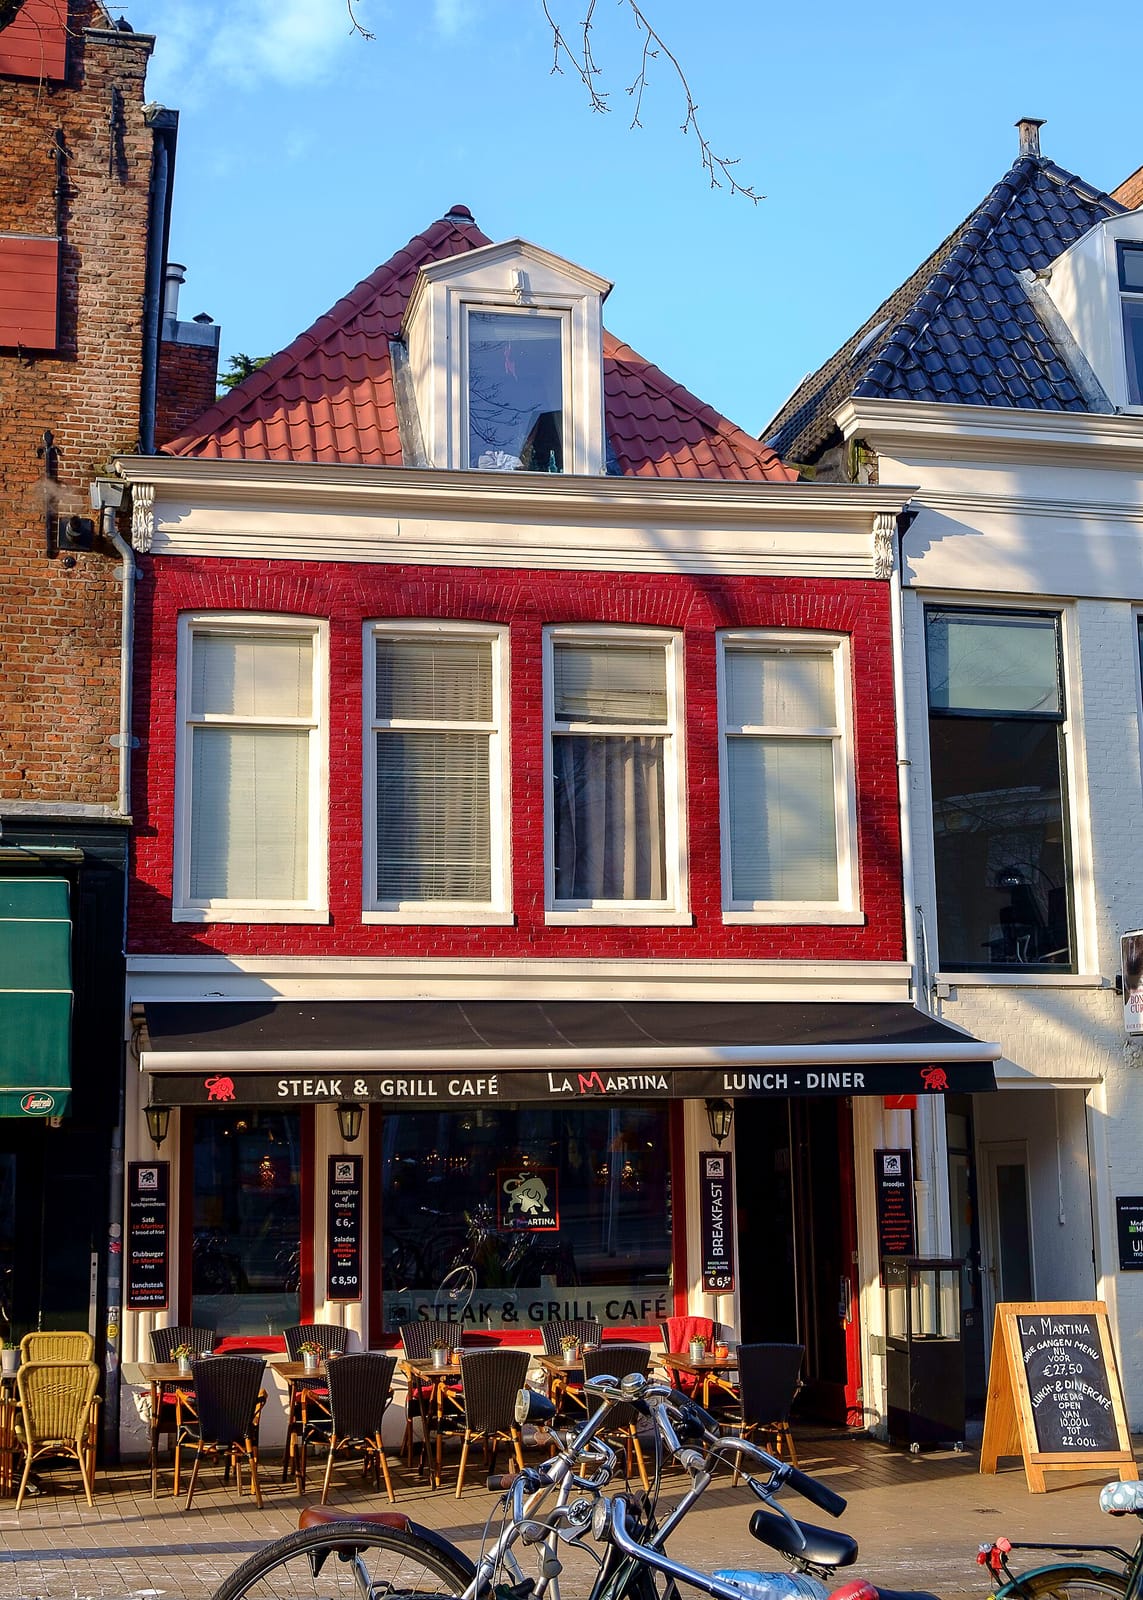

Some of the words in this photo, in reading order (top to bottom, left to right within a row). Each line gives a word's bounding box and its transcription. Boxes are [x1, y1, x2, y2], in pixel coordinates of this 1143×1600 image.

[277, 1079, 342, 1097] STEAK
[353, 1079, 369, 1096] &
[380, 1079, 437, 1096] GRILL
[448, 1075, 498, 1096] CAFÉ
[577, 1071, 668, 1093] MARTINA
[723, 1073, 788, 1090] LUNCH
[806, 1072, 865, 1089] DINER
[711, 1182, 724, 1256] BREAKFAST
[338, 1275, 358, 1286] 8,50
[417, 1303, 492, 1322] STEAK
[501, 1302, 519, 1322] &
[527, 1300, 596, 1321] GRILL
[605, 1294, 667, 1321] CAFÉ
[1040, 1317, 1090, 1336] MARTINA
[1036, 1338, 1072, 1351] GANGEN
[1073, 1341, 1100, 1360] MENU
[1053, 1347, 1066, 1356] NU
[1047, 1355, 1071, 1363] VOOR
[1055, 1380, 1063, 1393] &
[1069, 1393, 1085, 1401] DAG
[1058, 1402, 1081, 1410] OPEN
[1061, 1410, 1080, 1419] VAN
[1066, 1426, 1082, 1436] TOT
